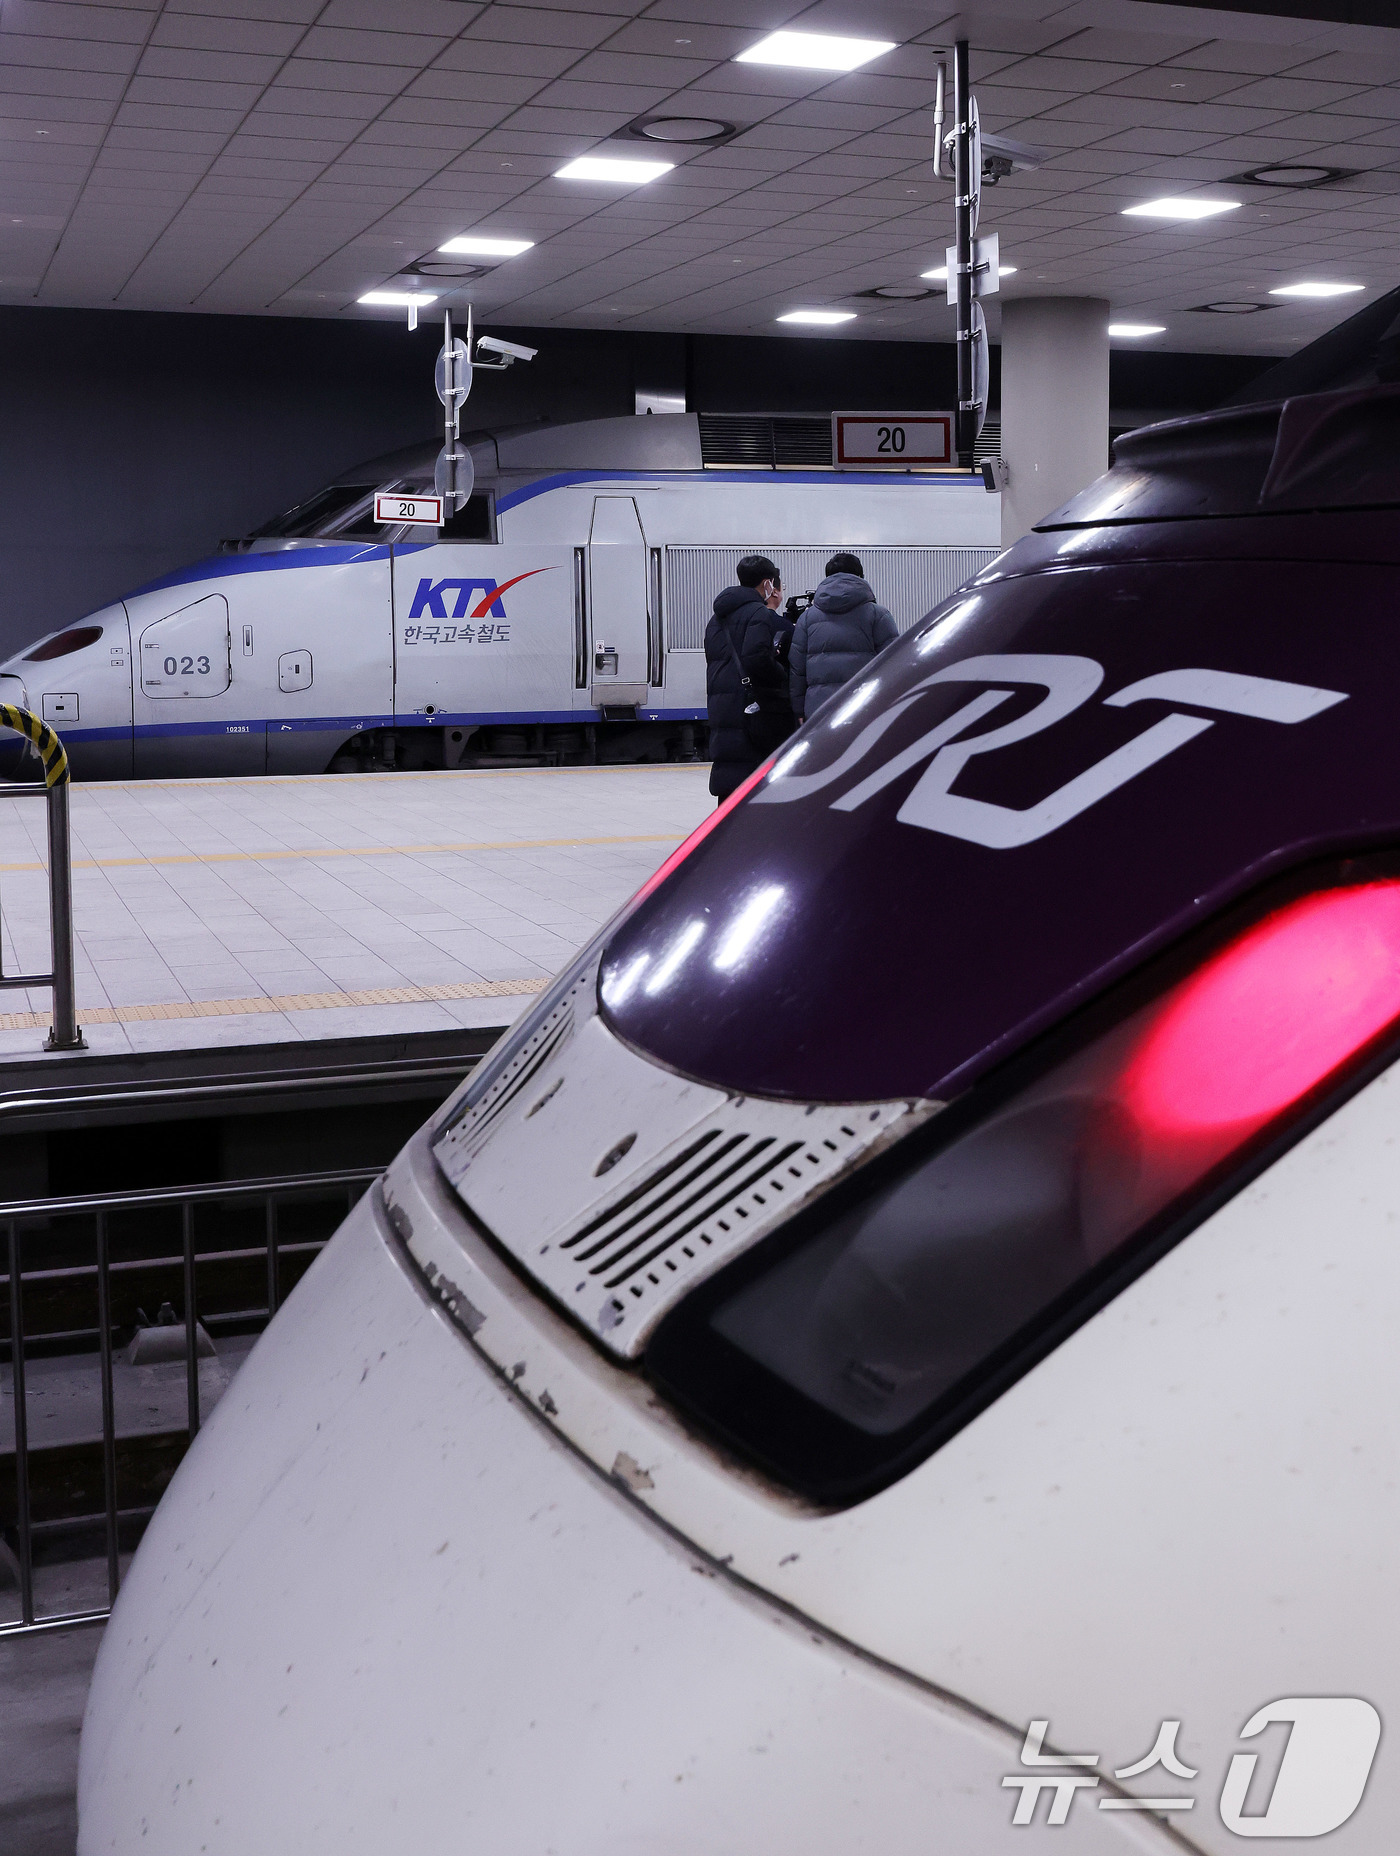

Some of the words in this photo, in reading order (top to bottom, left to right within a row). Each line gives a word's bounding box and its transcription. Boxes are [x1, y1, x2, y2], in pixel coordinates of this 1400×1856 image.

[877, 427, 906, 453] 20
[399, 502, 416, 516] 20
[408, 566, 563, 618] KTX
[404, 624, 511, 645] 한국고속철도
[163, 655, 211, 675] 023
[226, 726, 250, 734] 102351
[750, 654, 1350, 849] SRT
